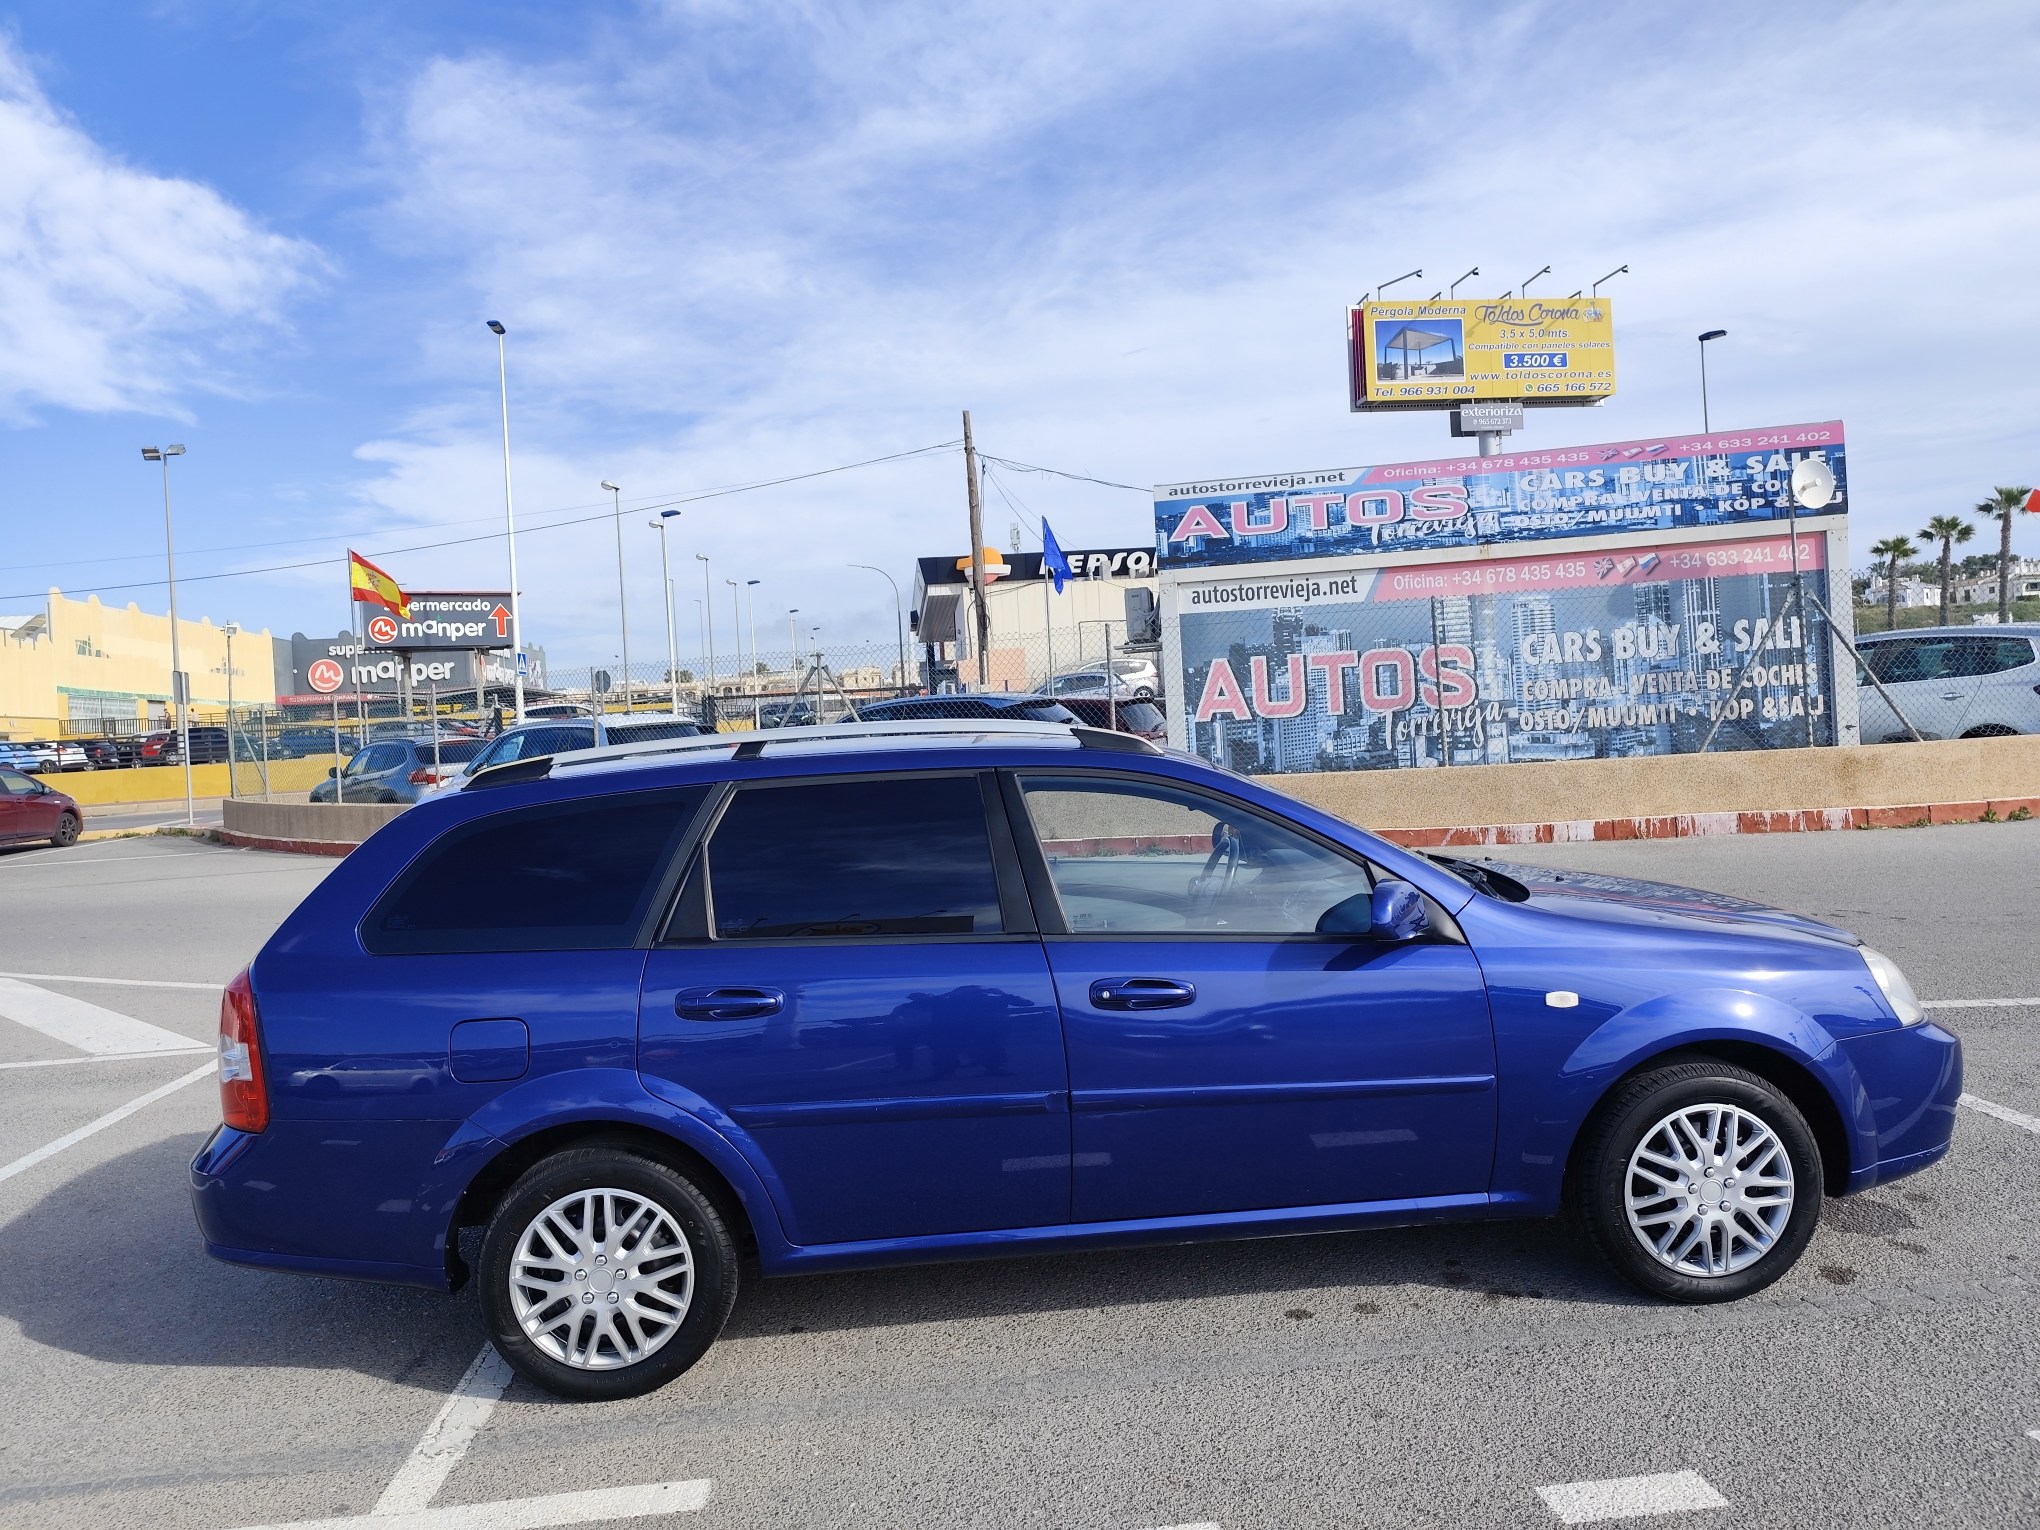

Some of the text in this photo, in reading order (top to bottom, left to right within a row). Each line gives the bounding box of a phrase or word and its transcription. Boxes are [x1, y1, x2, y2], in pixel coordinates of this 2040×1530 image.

[1417, 306, 1467, 316] Moderna
[1475, 303, 1580, 325] Toldos Corona
[1500, 329, 1516, 339] 3,5
[1528, 328, 1545, 339] 5,0
[1468, 342, 1520, 351] Compatible
[1541, 342, 1576, 351] paneles
[1509, 354, 1563, 367] 3.500 €
[1469, 369, 1612, 381] www.toldoscorona.es
[1374, 385, 1476, 397] Tel. 966 931 004
[1536, 382, 1612, 393] 665 166 572
[1461, 405, 1523, 417] exterioriza
[1679, 430, 1831, 452] +34 633 241 402
[1383, 451, 1590, 478] Oficina: +34 678 435 435
[1520, 469, 1605, 492] CARS
[1619, 461, 1690, 484] BUY
[1706, 459, 1732, 477] &
[1168, 471, 1346, 497] autostorrevieja.net
[1518, 492, 1616, 512] COMPRA
[1637, 484, 1708, 503] VENTA
[1715, 482, 1743, 496] DE
[1718, 495, 1766, 512] KÖP
[1168, 484, 1472, 543] AUTOS
[1370, 511, 1500, 546] Torrevieja
[1039, 550, 1158, 576] EPSO
[1669, 552, 1702, 569] +34
[1705, 550, 1740, 567] 633
[1742, 546, 1775, 564] 241
[1393, 561, 1587, 591] Oficina: +34 678 435 435
[1191, 575, 1359, 606] autostorrevieja.net
[384, 598, 491, 612] ermercado
[401, 619, 487, 642] manper
[1522, 628, 1602, 666] CARS
[1614, 623, 1681, 660] BUY
[1695, 621, 1721, 655] &
[1194, 644, 1479, 723] AUTOS
[1522, 676, 1613, 701] COMPRA
[1630, 670, 1699, 696] VENTA
[1705, 668, 1733, 691] DE
[1375, 698, 1505, 751] Torrevieja
